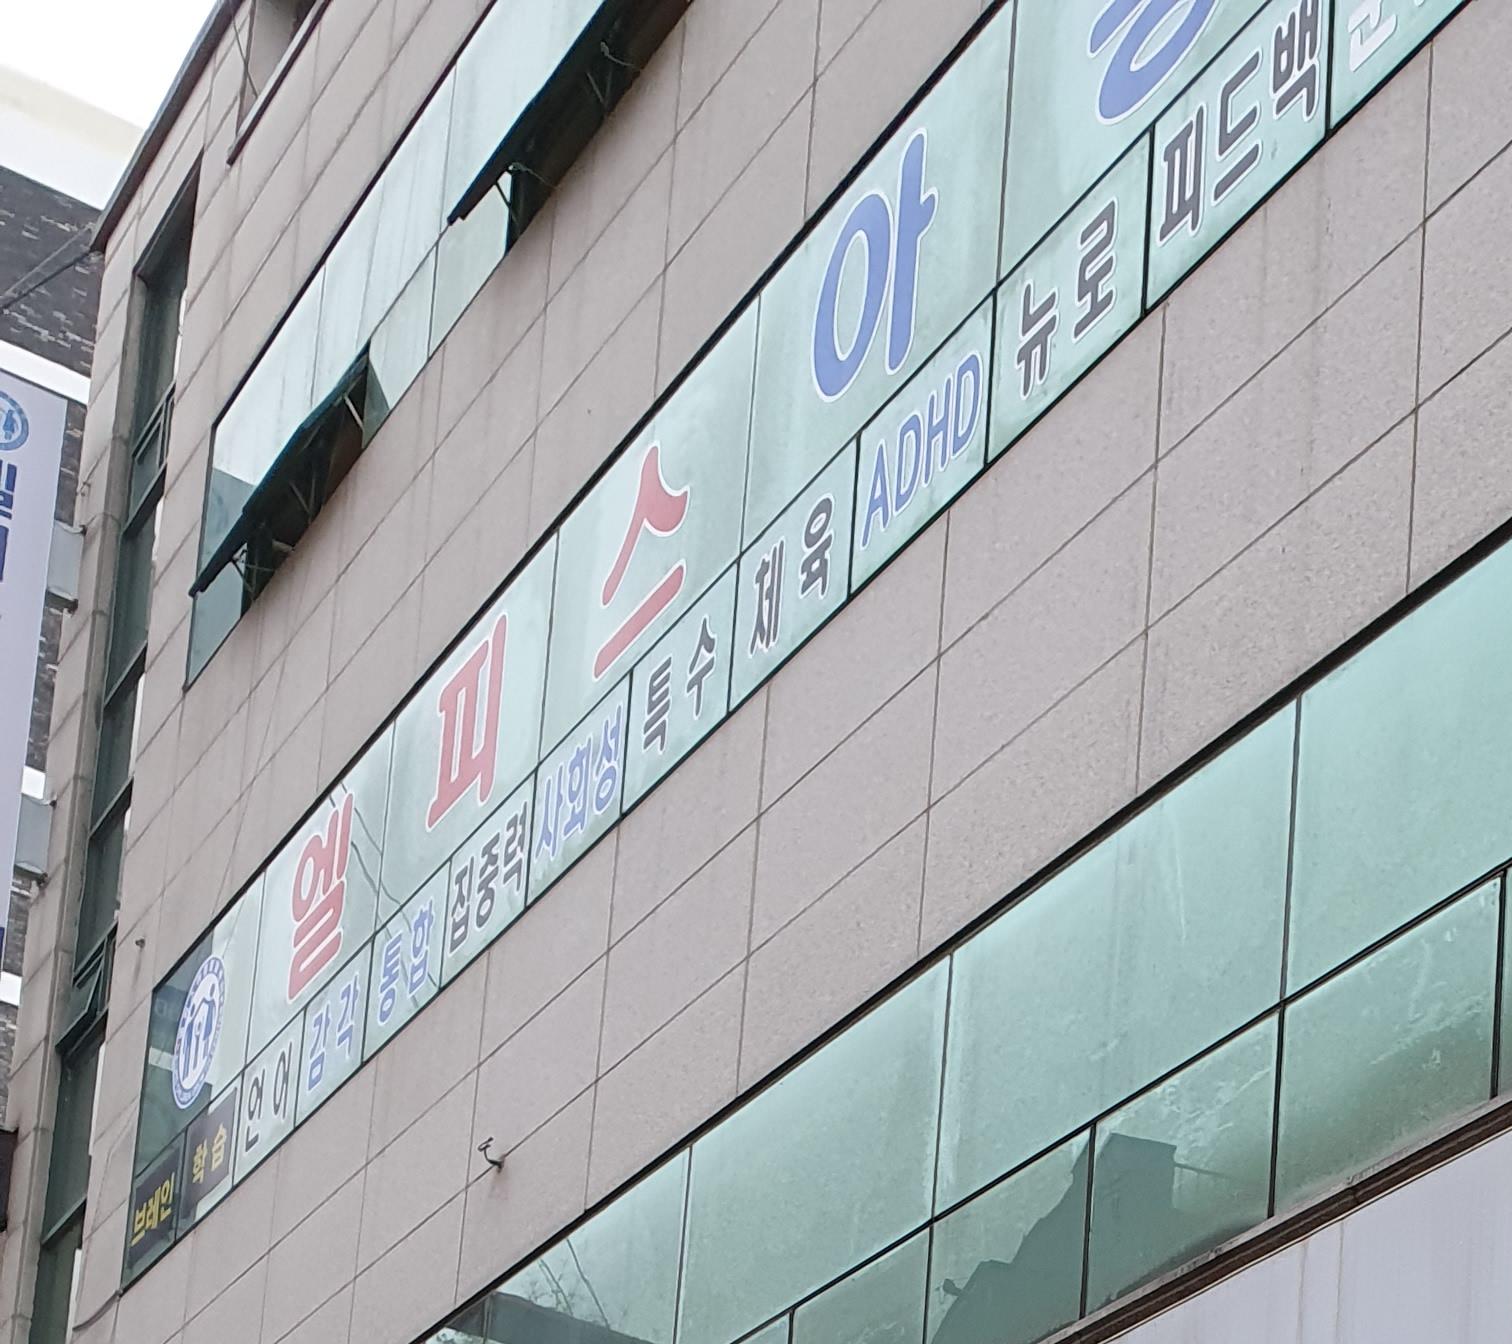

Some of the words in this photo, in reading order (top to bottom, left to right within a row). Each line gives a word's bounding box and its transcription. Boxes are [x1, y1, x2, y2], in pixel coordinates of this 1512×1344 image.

[1015, 197, 1117, 400] 뉴로
[1159, 0, 1322, 247] 피드백
[861, 350, 982, 550] ADHD
[131, 1172, 175, 1247] 브레인
[192, 1123, 227, 1183] 학습
[244, 1041, 292, 1152] 언어
[307, 972, 360, 1091] 감각
[377, 899, 434, 1026] 통합
[449, 800, 527, 956] 집중력
[533, 703, 623, 863] 사회성
[642, 614, 716, 755] 특수
[748, 493, 834, 658] 체육
